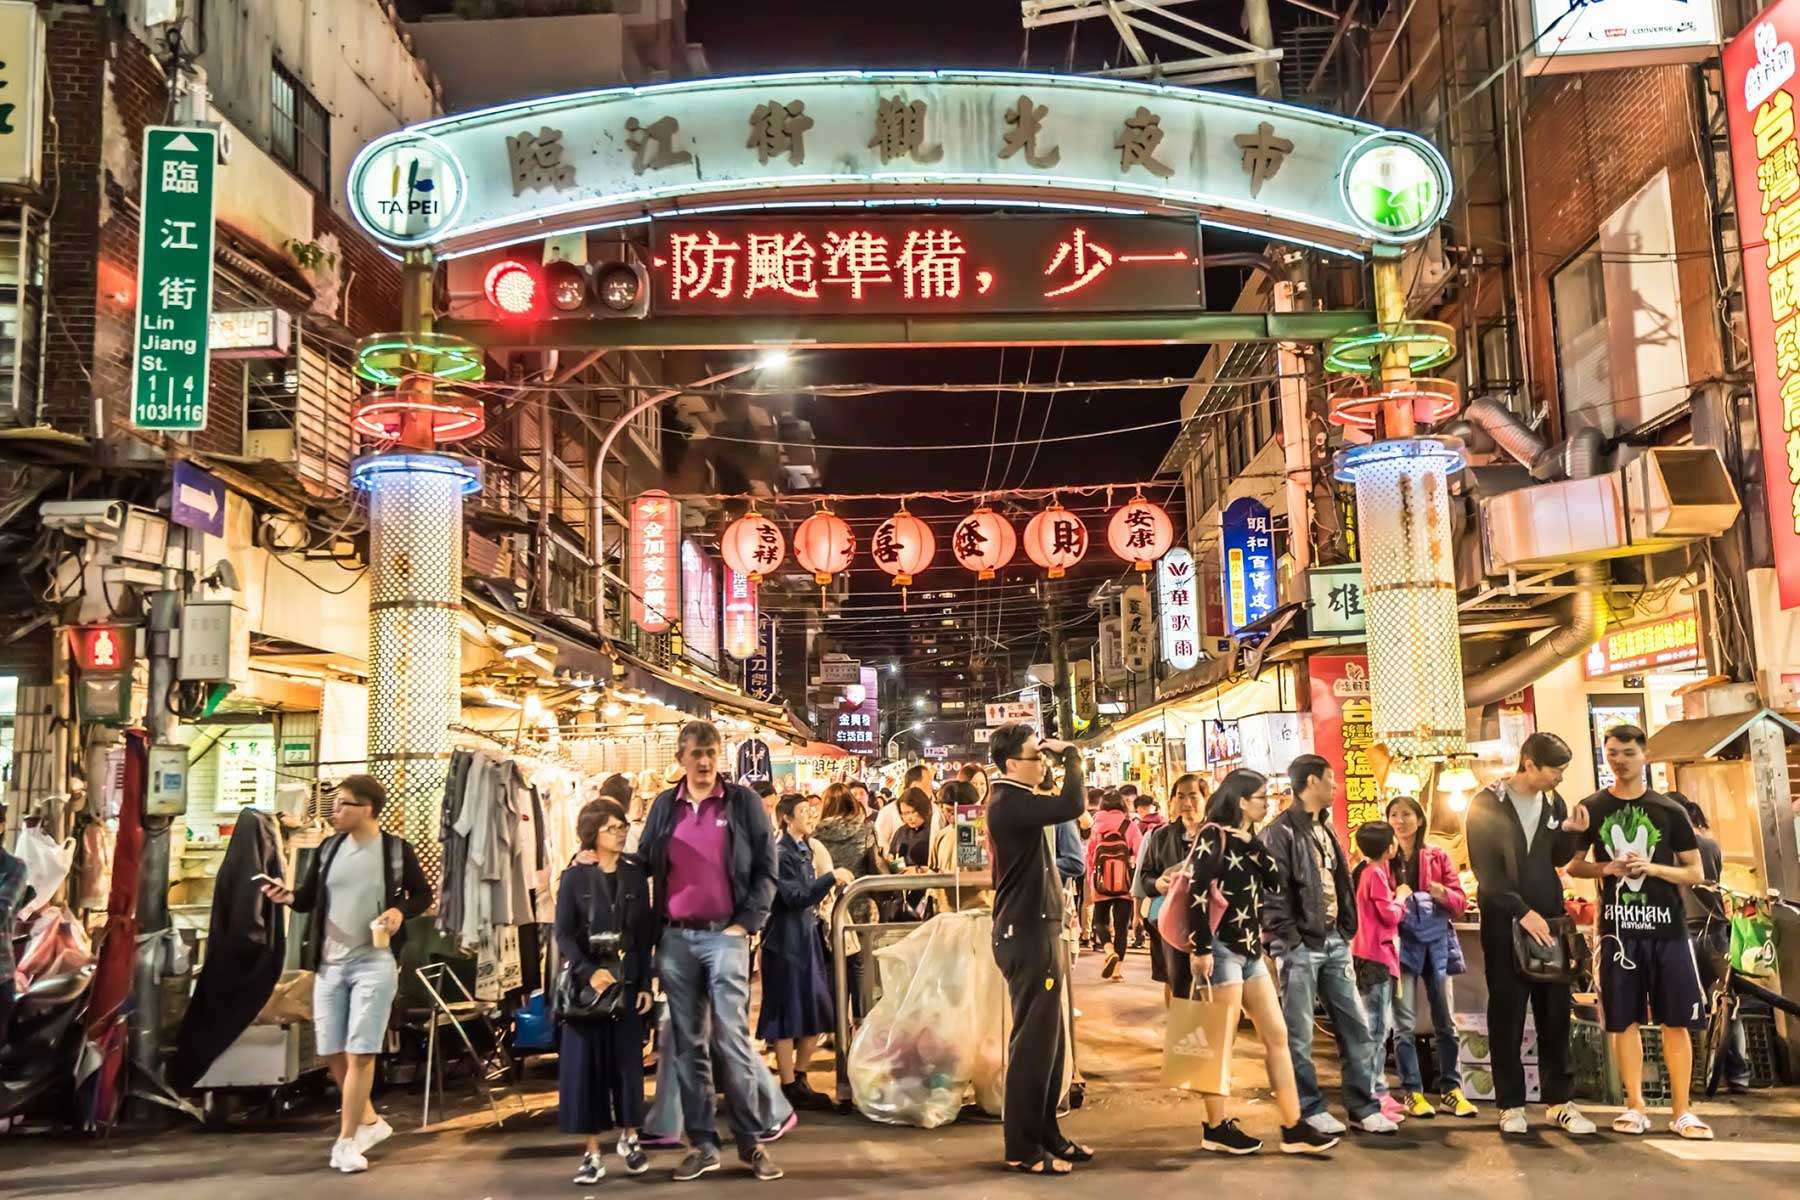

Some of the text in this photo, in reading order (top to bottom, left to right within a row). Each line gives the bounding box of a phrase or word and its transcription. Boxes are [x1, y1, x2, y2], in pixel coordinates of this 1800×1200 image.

[506, 94, 1294, 199] 臨江街觀光夜市
[158, 160, 199, 311] 臨江街
[143, 315, 175, 331] Lin
[142, 336, 197, 355] Jiang
[142, 355, 168, 373] St.
[149, 375, 157, 391] 1
[183, 375, 194, 392] 4
[137, 404, 168, 421] 103
[173, 404, 202, 421] 116
[1052, 518, 1086, 557] 財
[1124, 509, 1156, 549] 安康
[752, 523, 778, 565] 吉祥
[874, 523, 904, 563] 喜
[1328, 582, 1365, 621] 雄
[1604, 904, 1672, 924] ARKHAM
[1690, 1002, 1700, 1021] 1
